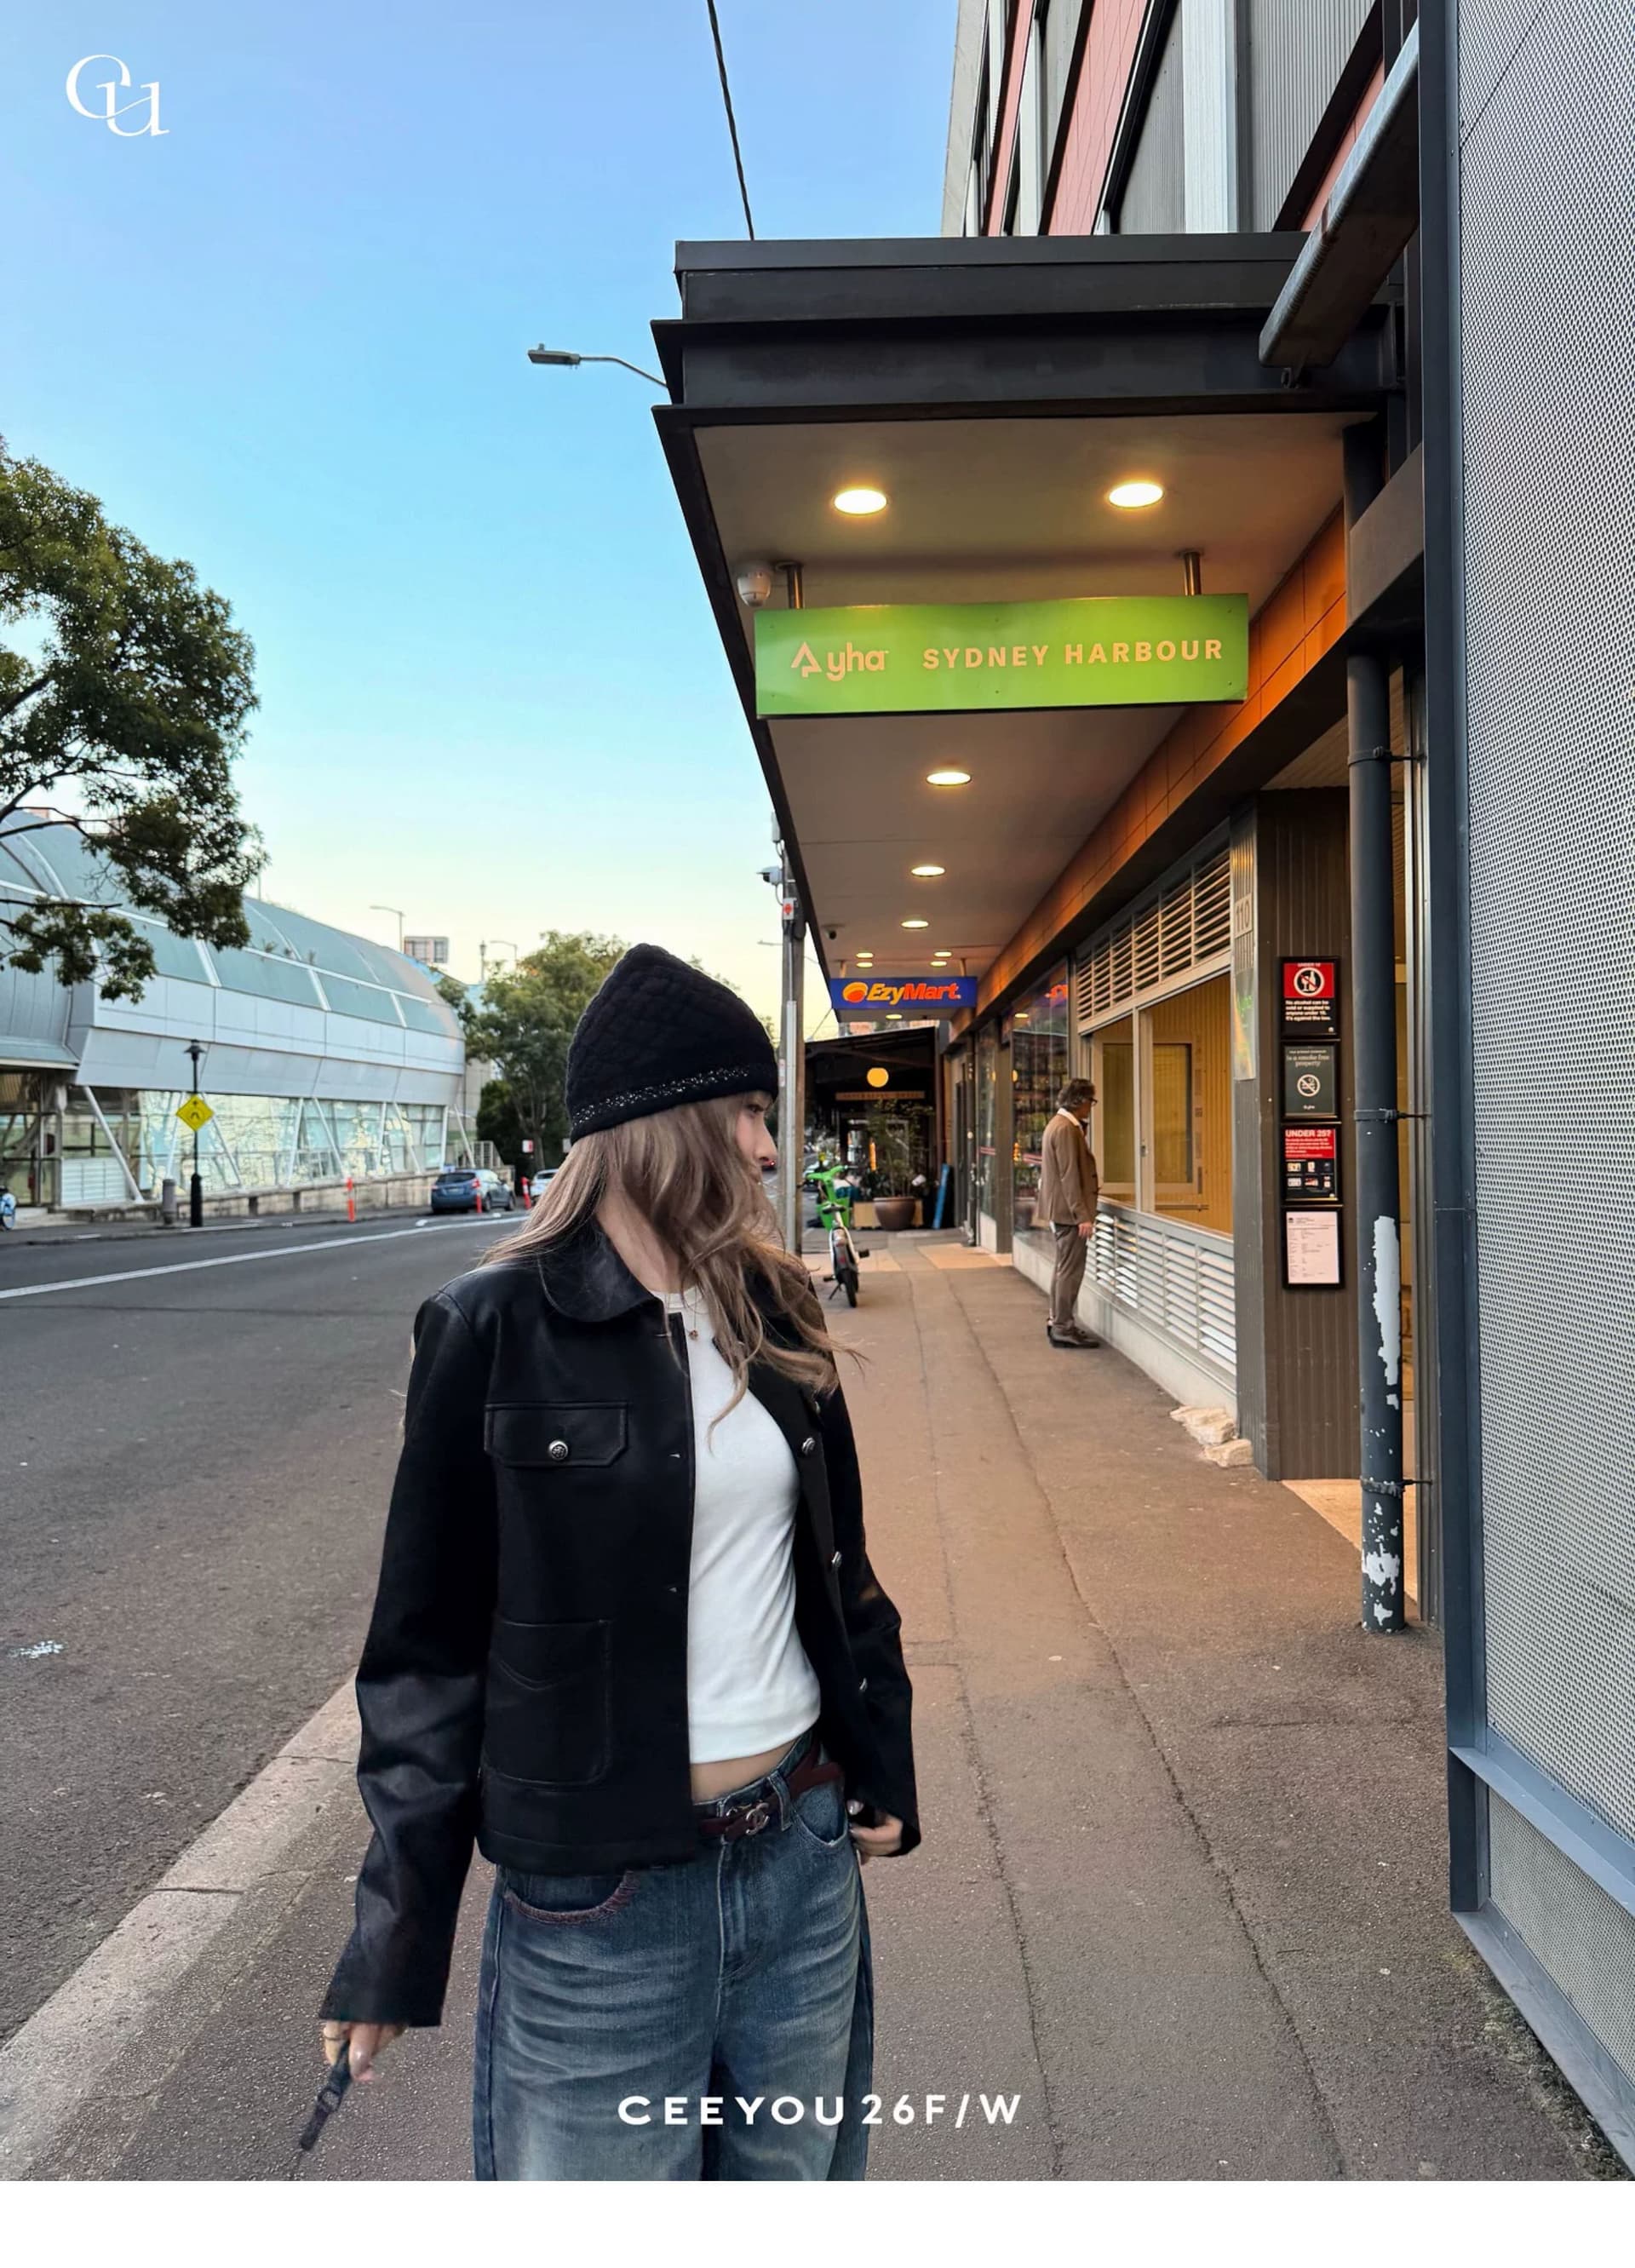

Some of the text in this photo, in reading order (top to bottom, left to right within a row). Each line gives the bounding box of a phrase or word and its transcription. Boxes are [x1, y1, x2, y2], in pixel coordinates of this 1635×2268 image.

[825, 640, 1223, 682] yha SYDNEY HARBOUR
[866, 982, 960, 1005] EzyMart
[1285, 1128, 1316, 1138] UNDER
